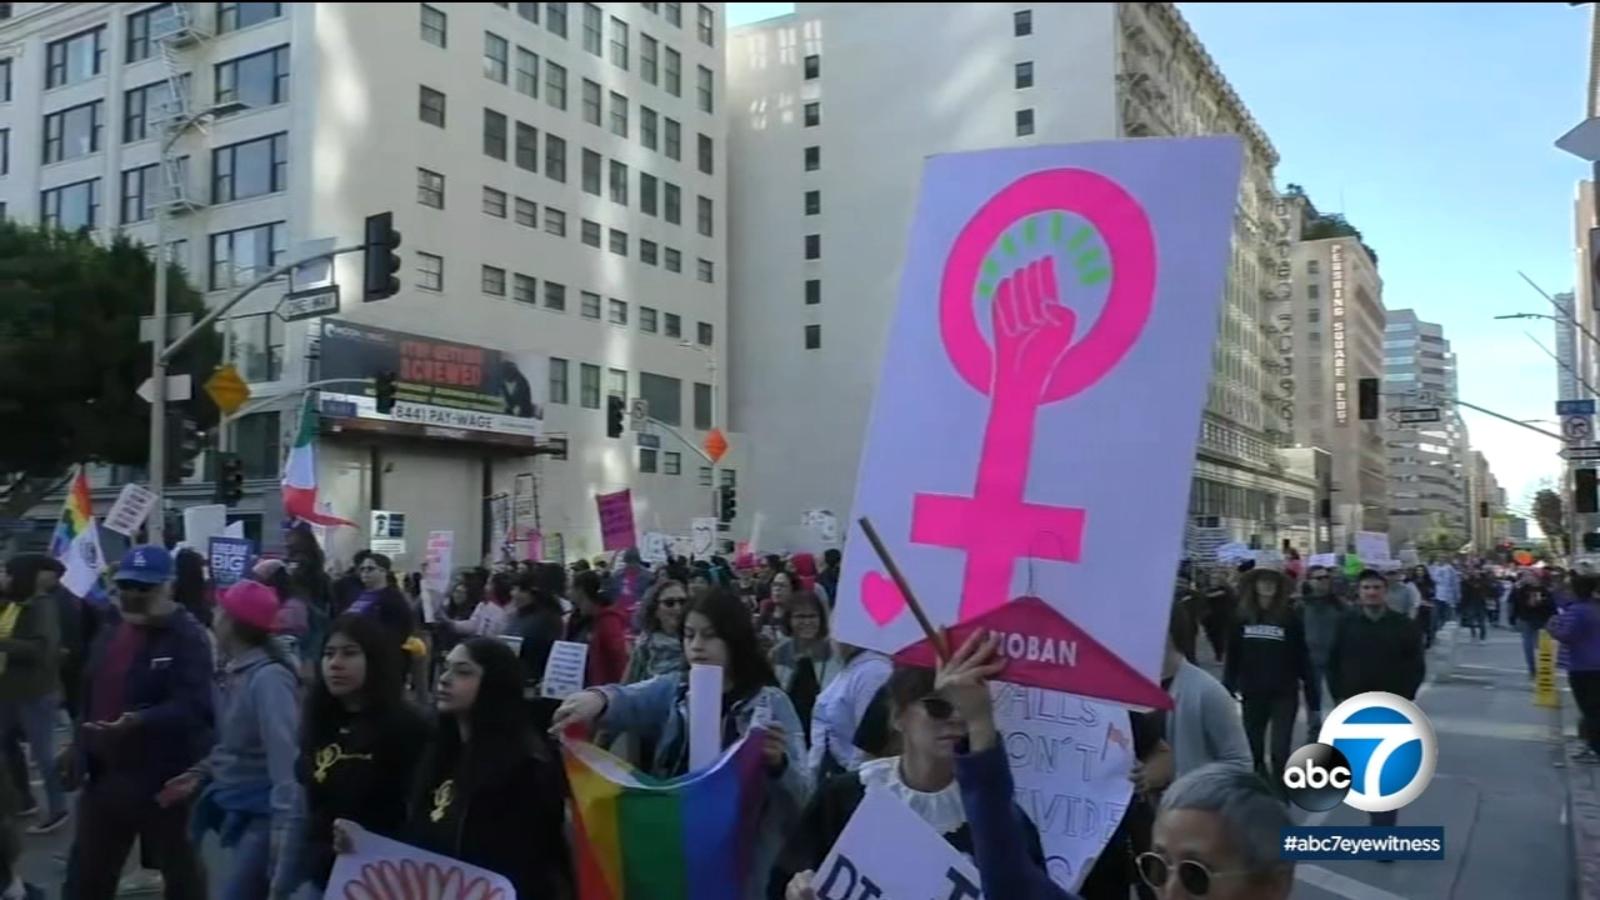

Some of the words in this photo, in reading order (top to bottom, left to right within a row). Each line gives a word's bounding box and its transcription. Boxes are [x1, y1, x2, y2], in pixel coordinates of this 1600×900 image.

[1331, 244, 1345, 316] PERSHING
[1333, 322, 1347, 377] SQUARE
[428, 408, 494, 429] PAY-WAGE
[212, 554, 245, 571] BIG
[1005, 731, 1099, 782] ON'T
